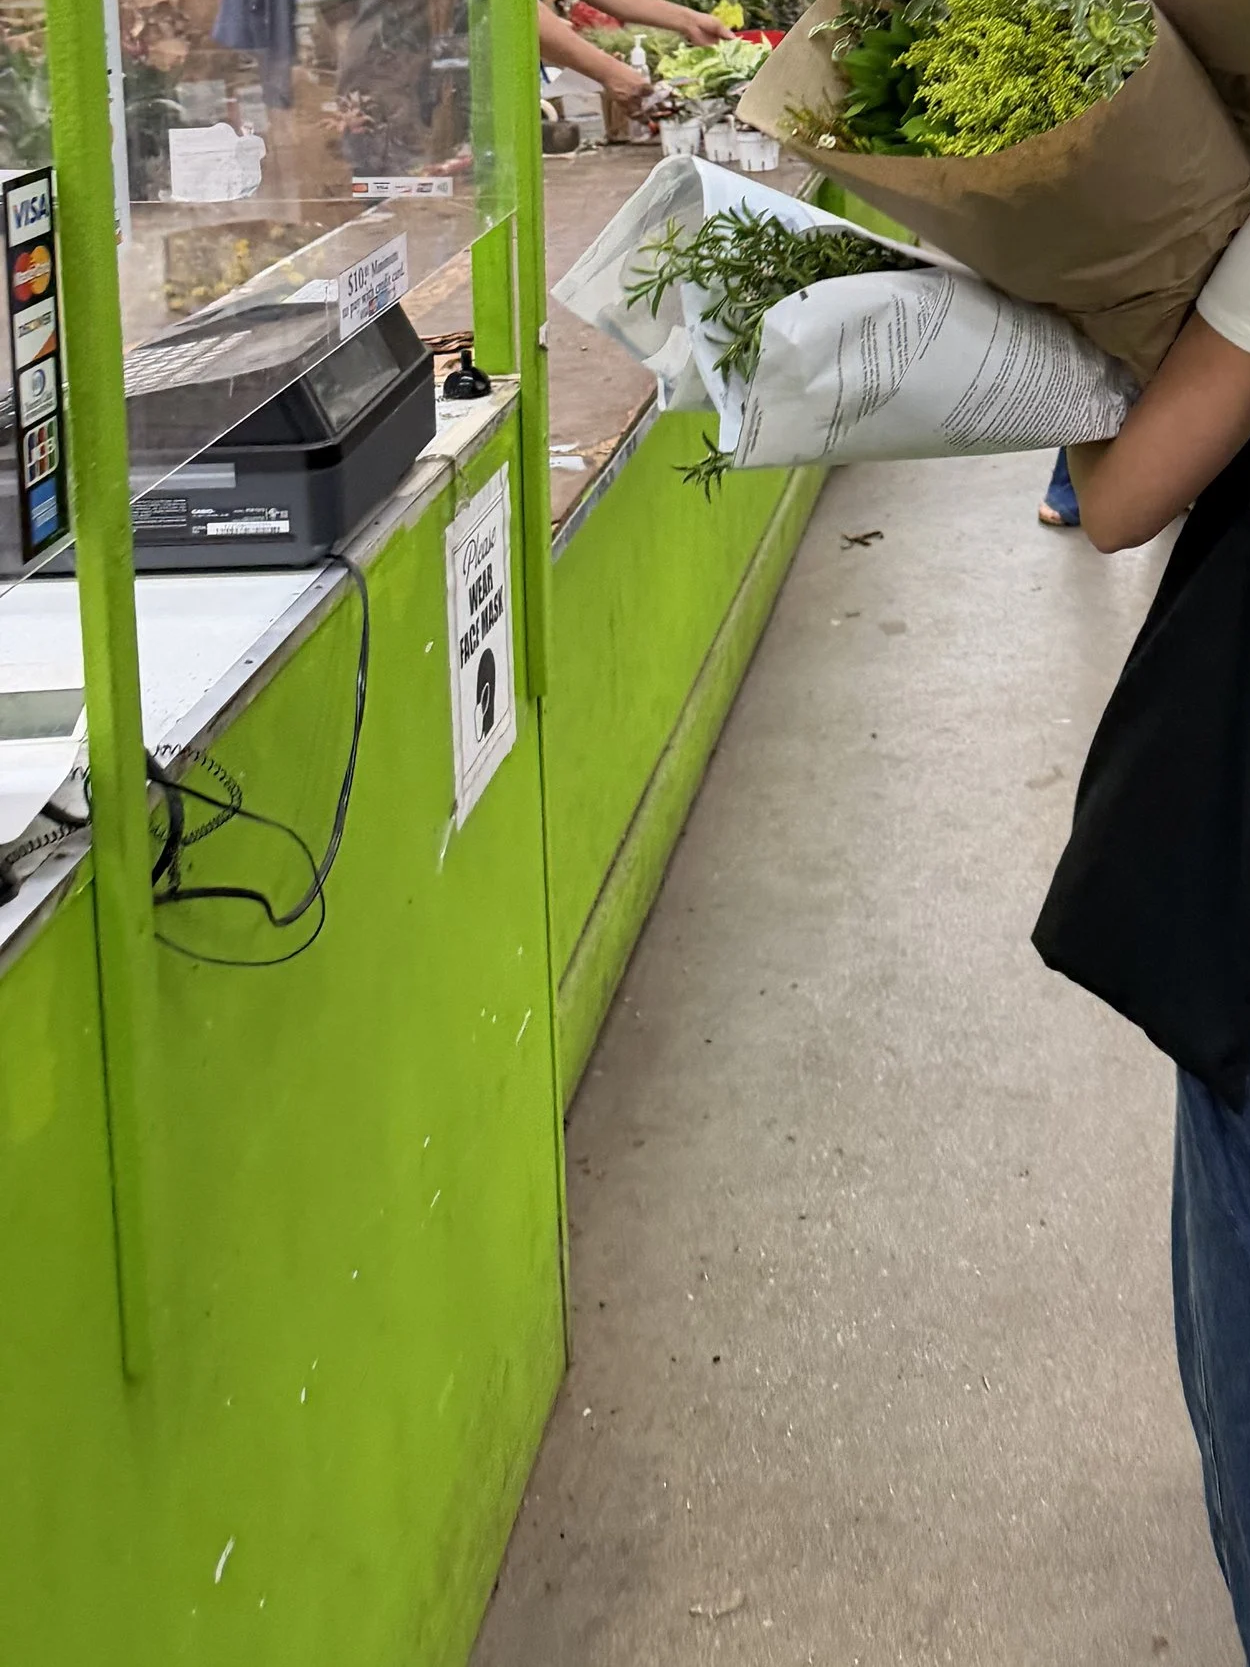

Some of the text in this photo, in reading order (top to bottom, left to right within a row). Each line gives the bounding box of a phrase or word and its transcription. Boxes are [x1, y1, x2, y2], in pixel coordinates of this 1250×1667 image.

[12, 193, 50, 230] VISA
[463, 526, 497, 585] Please
[469, 563, 494, 616] WEAR
[460, 584, 504, 669] FACE MASK
